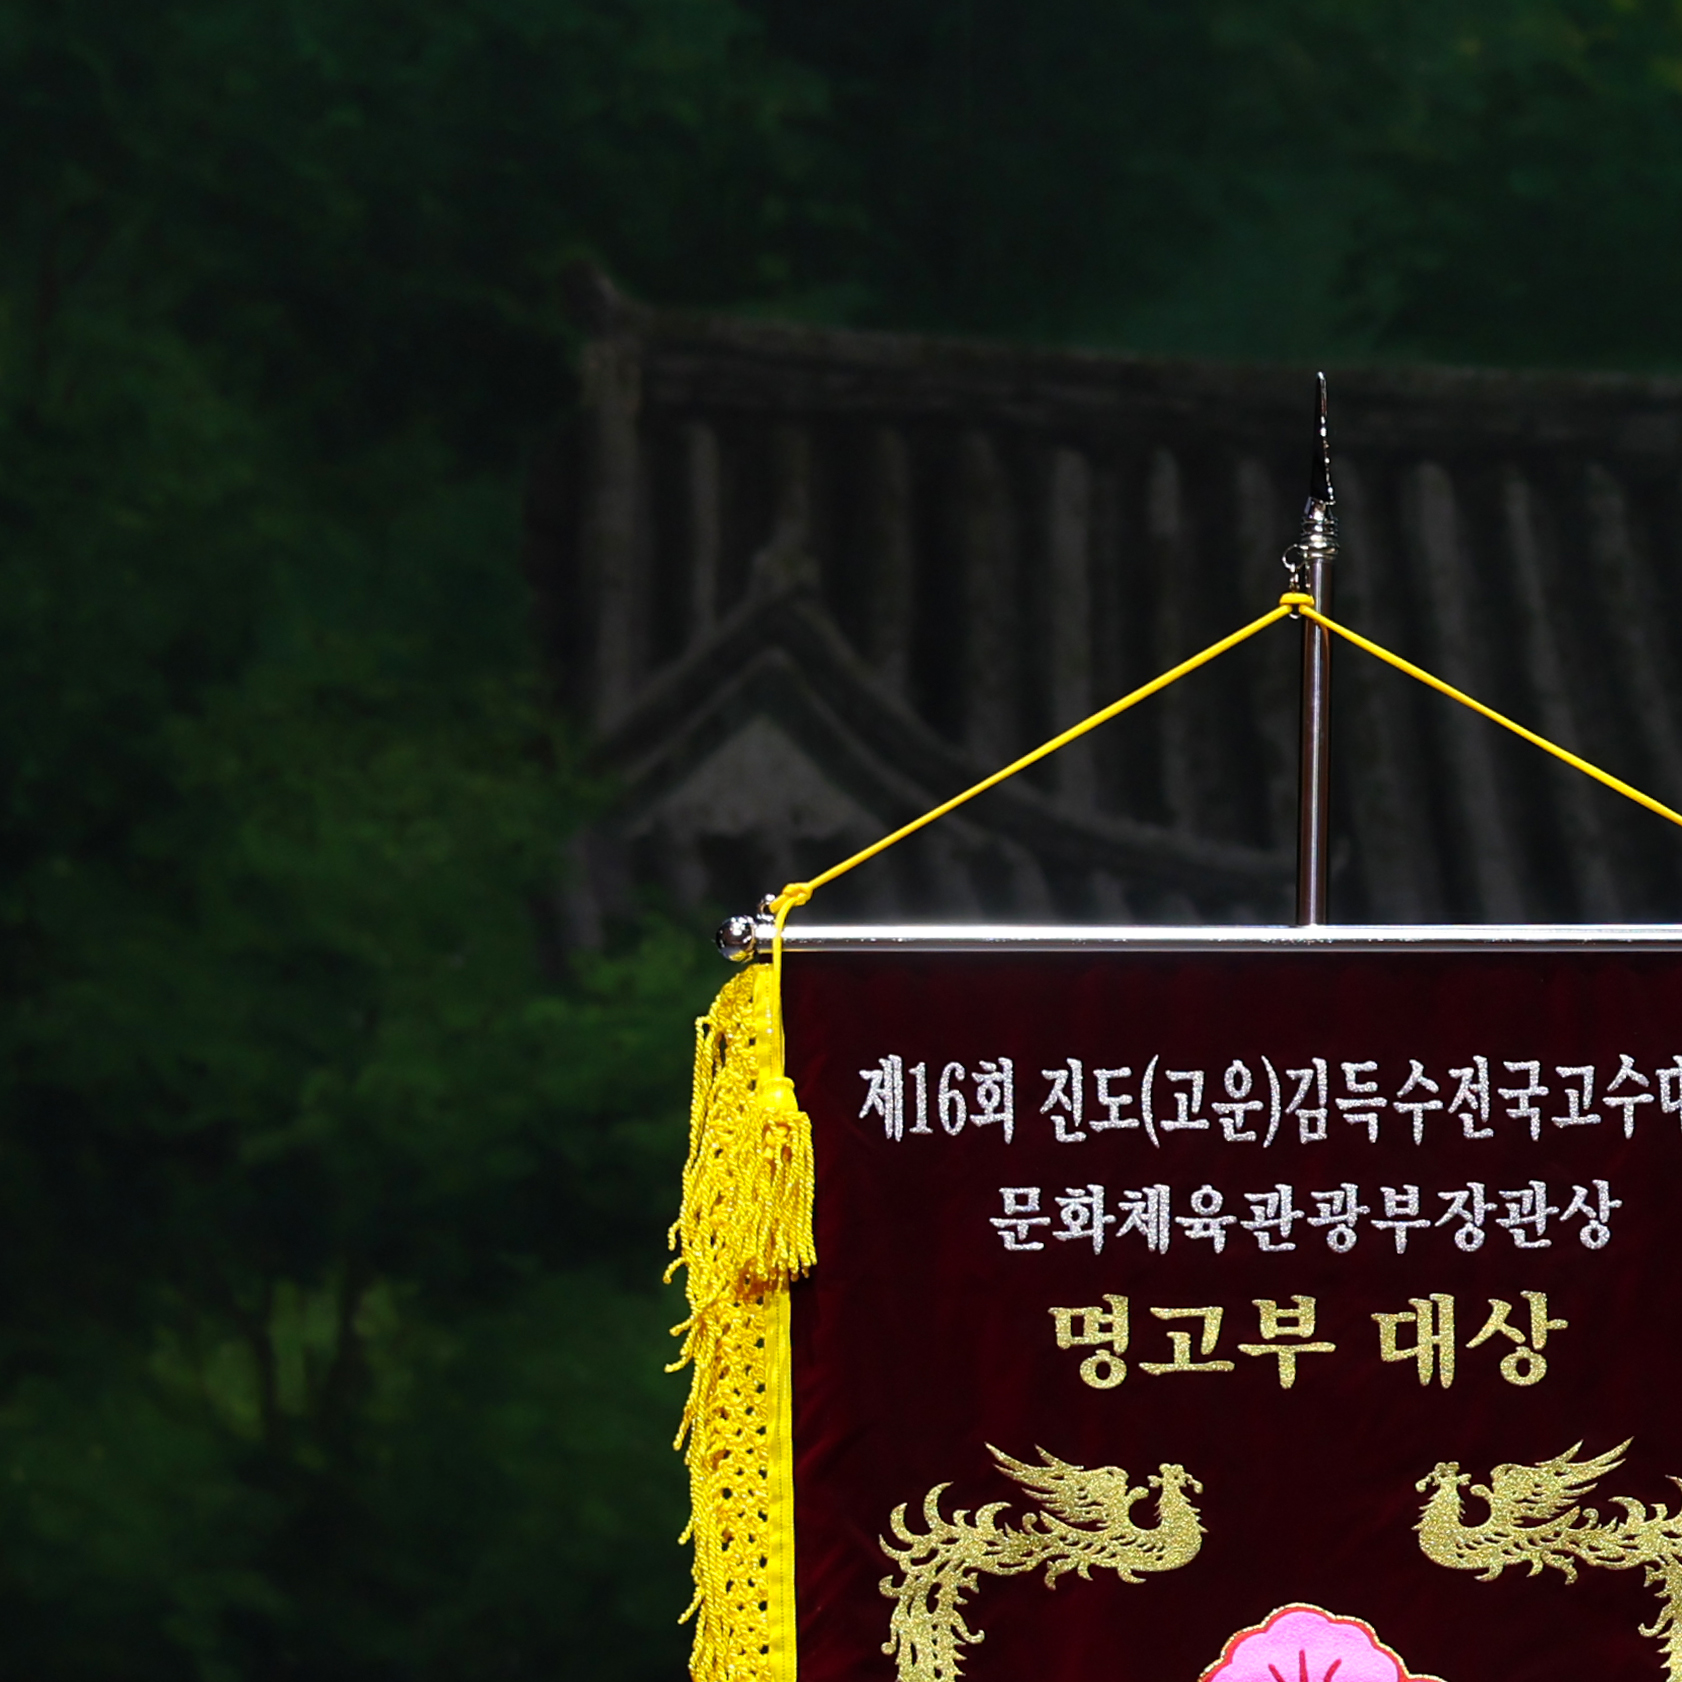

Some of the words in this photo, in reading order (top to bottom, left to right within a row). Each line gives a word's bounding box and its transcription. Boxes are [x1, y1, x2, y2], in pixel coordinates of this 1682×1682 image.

[859, 1054, 1013, 1144] 제16회
[990, 1180, 1622, 1254] 문화체육관광부장관상
[1048, 1294, 1336, 1389] 명고부
[1371, 1291, 1568, 1388] 대상
